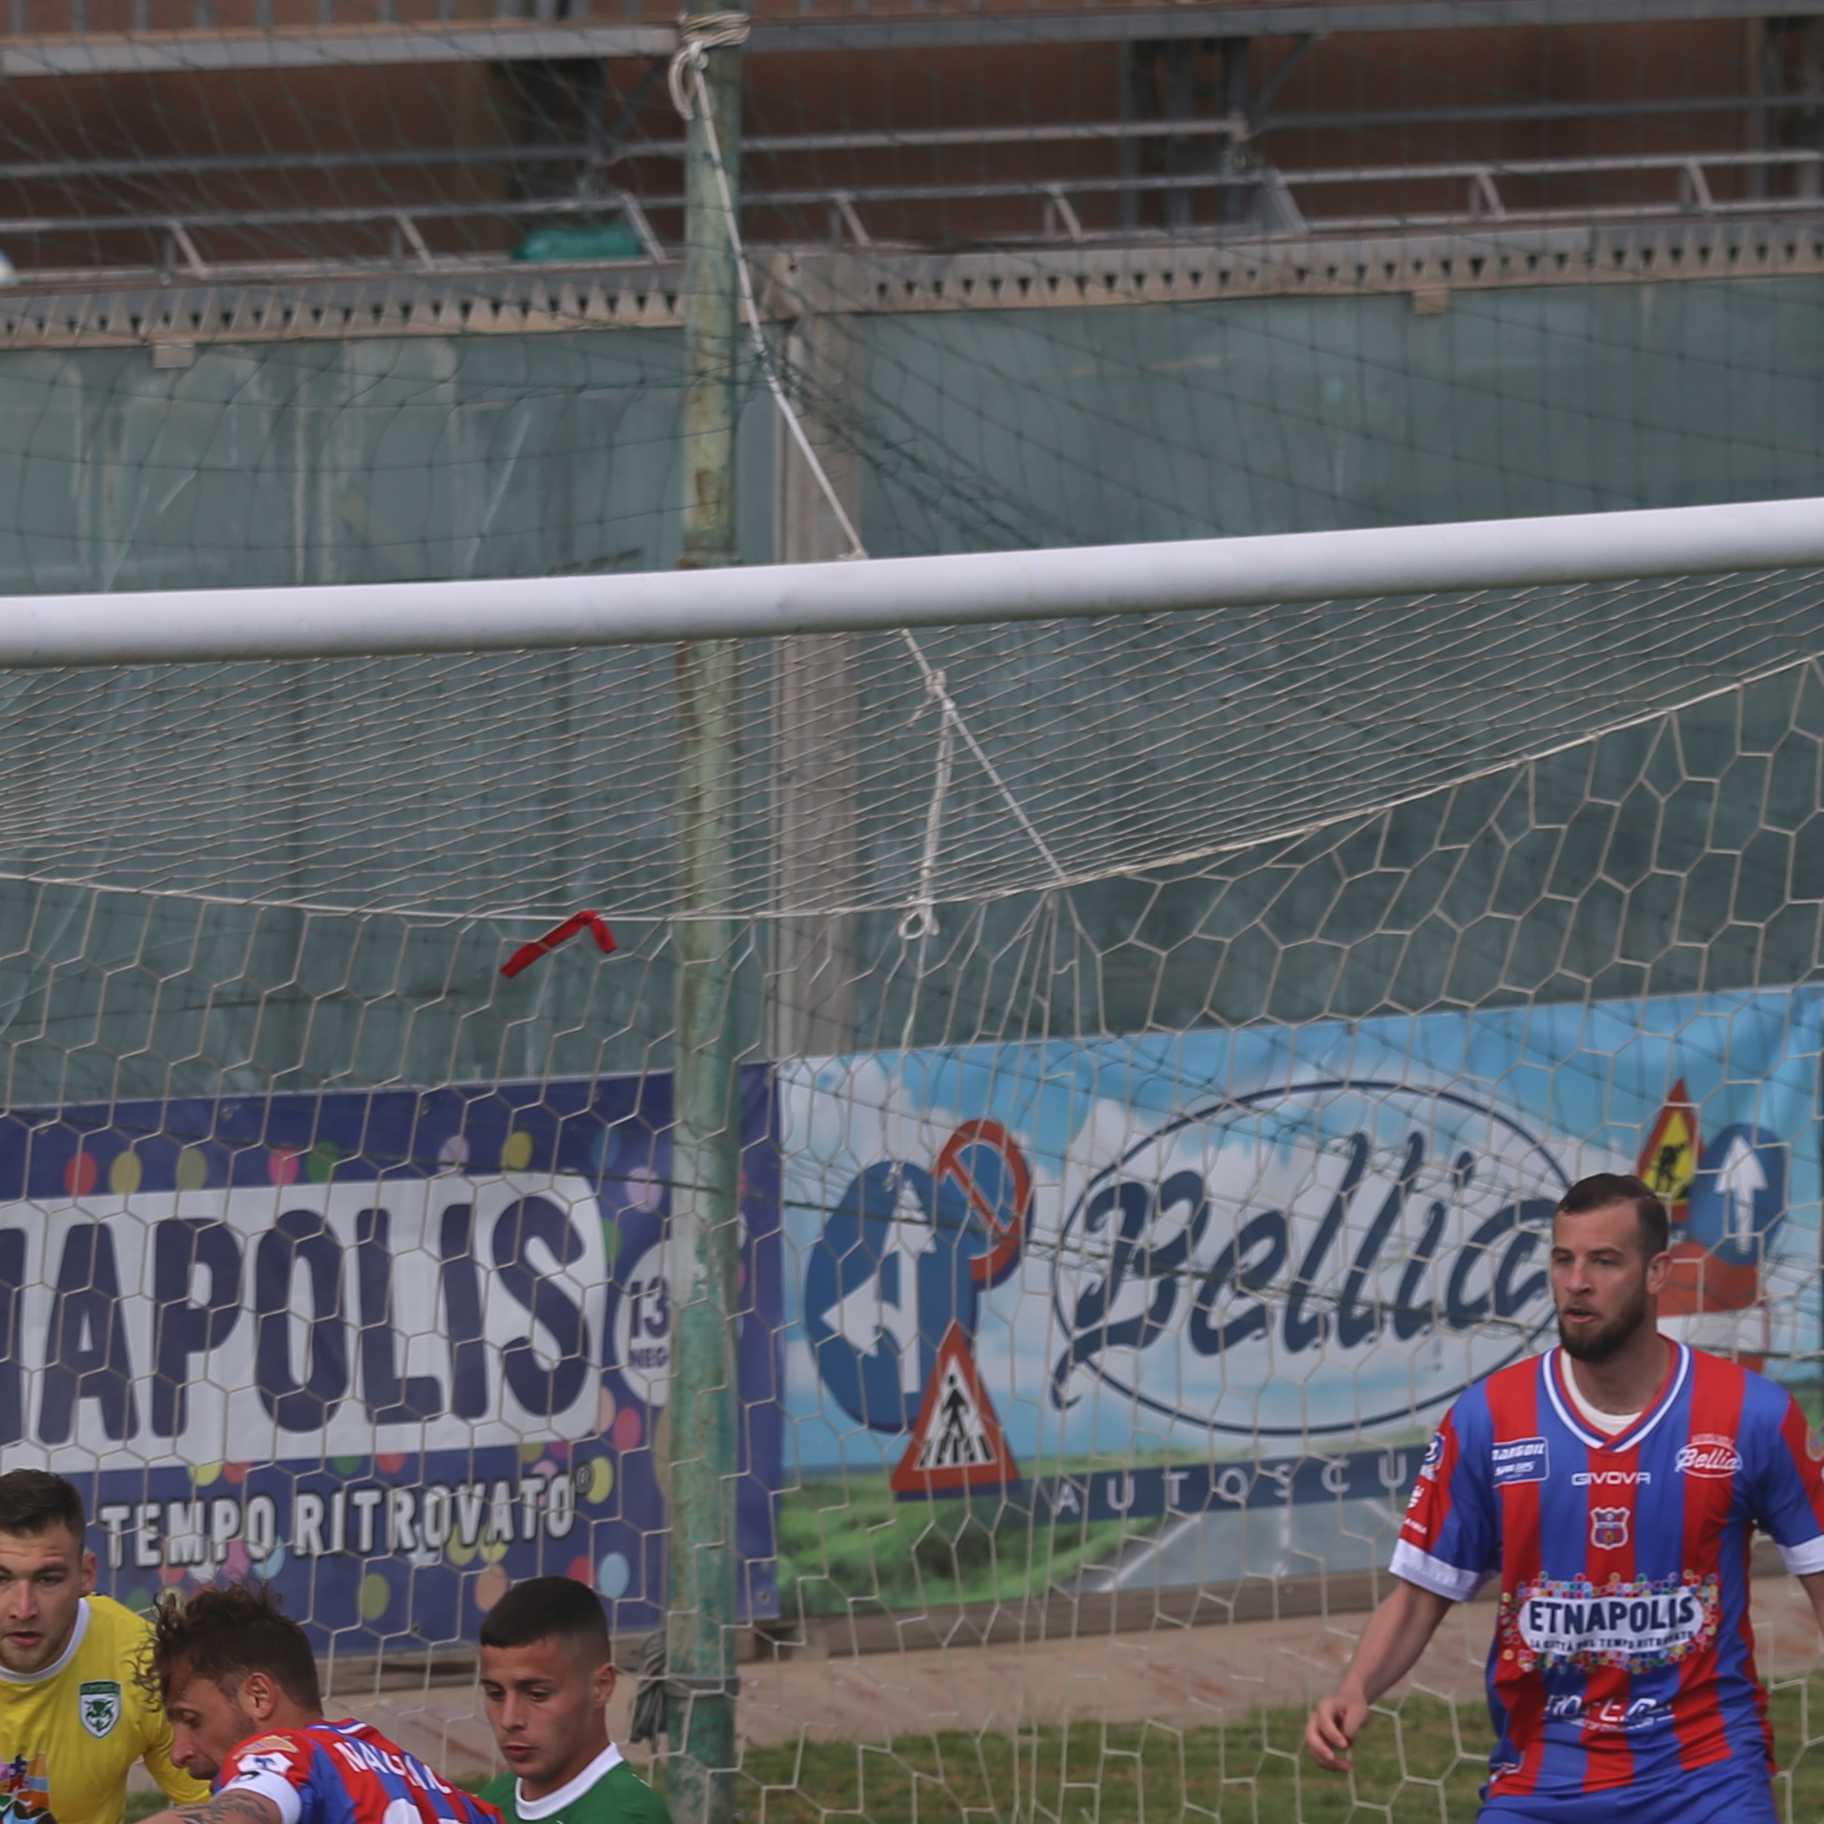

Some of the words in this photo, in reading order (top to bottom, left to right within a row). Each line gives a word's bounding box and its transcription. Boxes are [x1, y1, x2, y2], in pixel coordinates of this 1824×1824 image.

[1051, 1128, 1553, 1409] Bellia
[630, 1275, 670, 1339] 13
[1055, 1452, 1408, 1516] AUTOSCU
[1571, 1471, 1652, 1486] GIVOVA
[100, 1496, 276, 1569] TEMPO
[296, 1473, 576, 1558] RITROVATO
[1529, 1596, 1695, 1635] ETNAPOLIS
